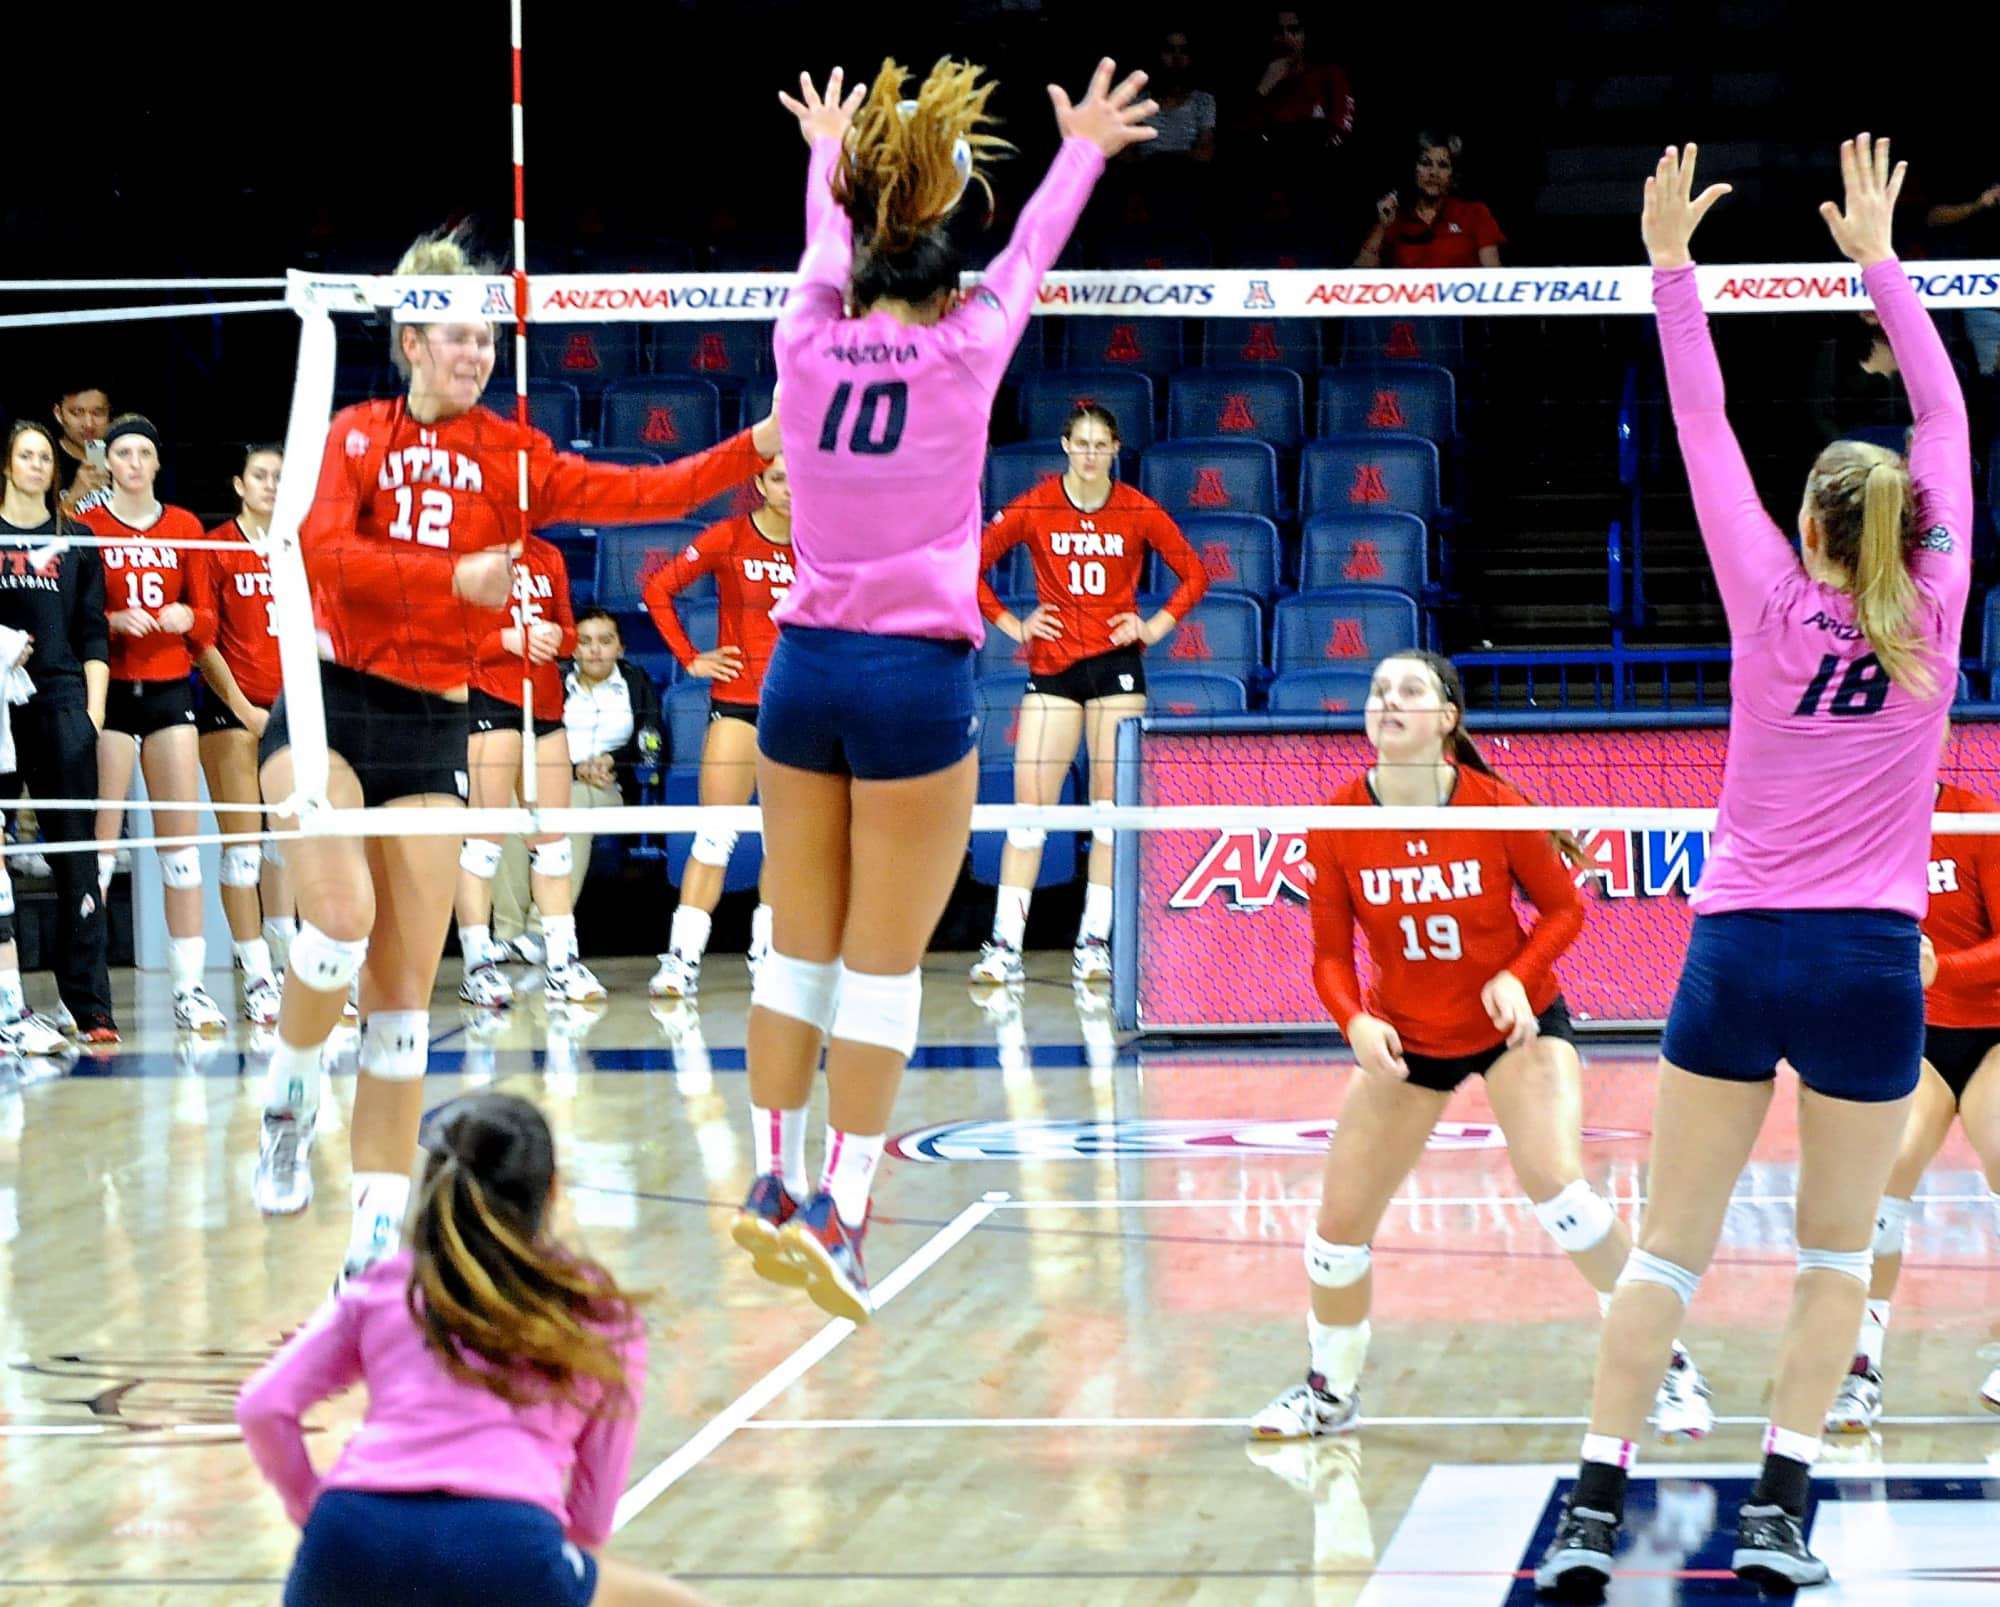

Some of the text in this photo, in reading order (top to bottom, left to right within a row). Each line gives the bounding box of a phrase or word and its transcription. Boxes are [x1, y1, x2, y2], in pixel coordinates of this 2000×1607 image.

[818, 380, 908, 455] 10
[378, 446, 483, 494] UTAH
[388, 486, 453, 549] 12
[104, 547, 178, 569] UTAH
[1051, 532, 1125, 557] UTAH
[126, 571, 164, 608] 16
[234, 572, 272, 596] UT
[743, 559, 798, 584] UTA
[1067, 560, 1106, 595] 10
[1794, 652, 1891, 716] 18
[1360, 859, 1483, 906] UTAH
[1399, 914, 1463, 961] 19
